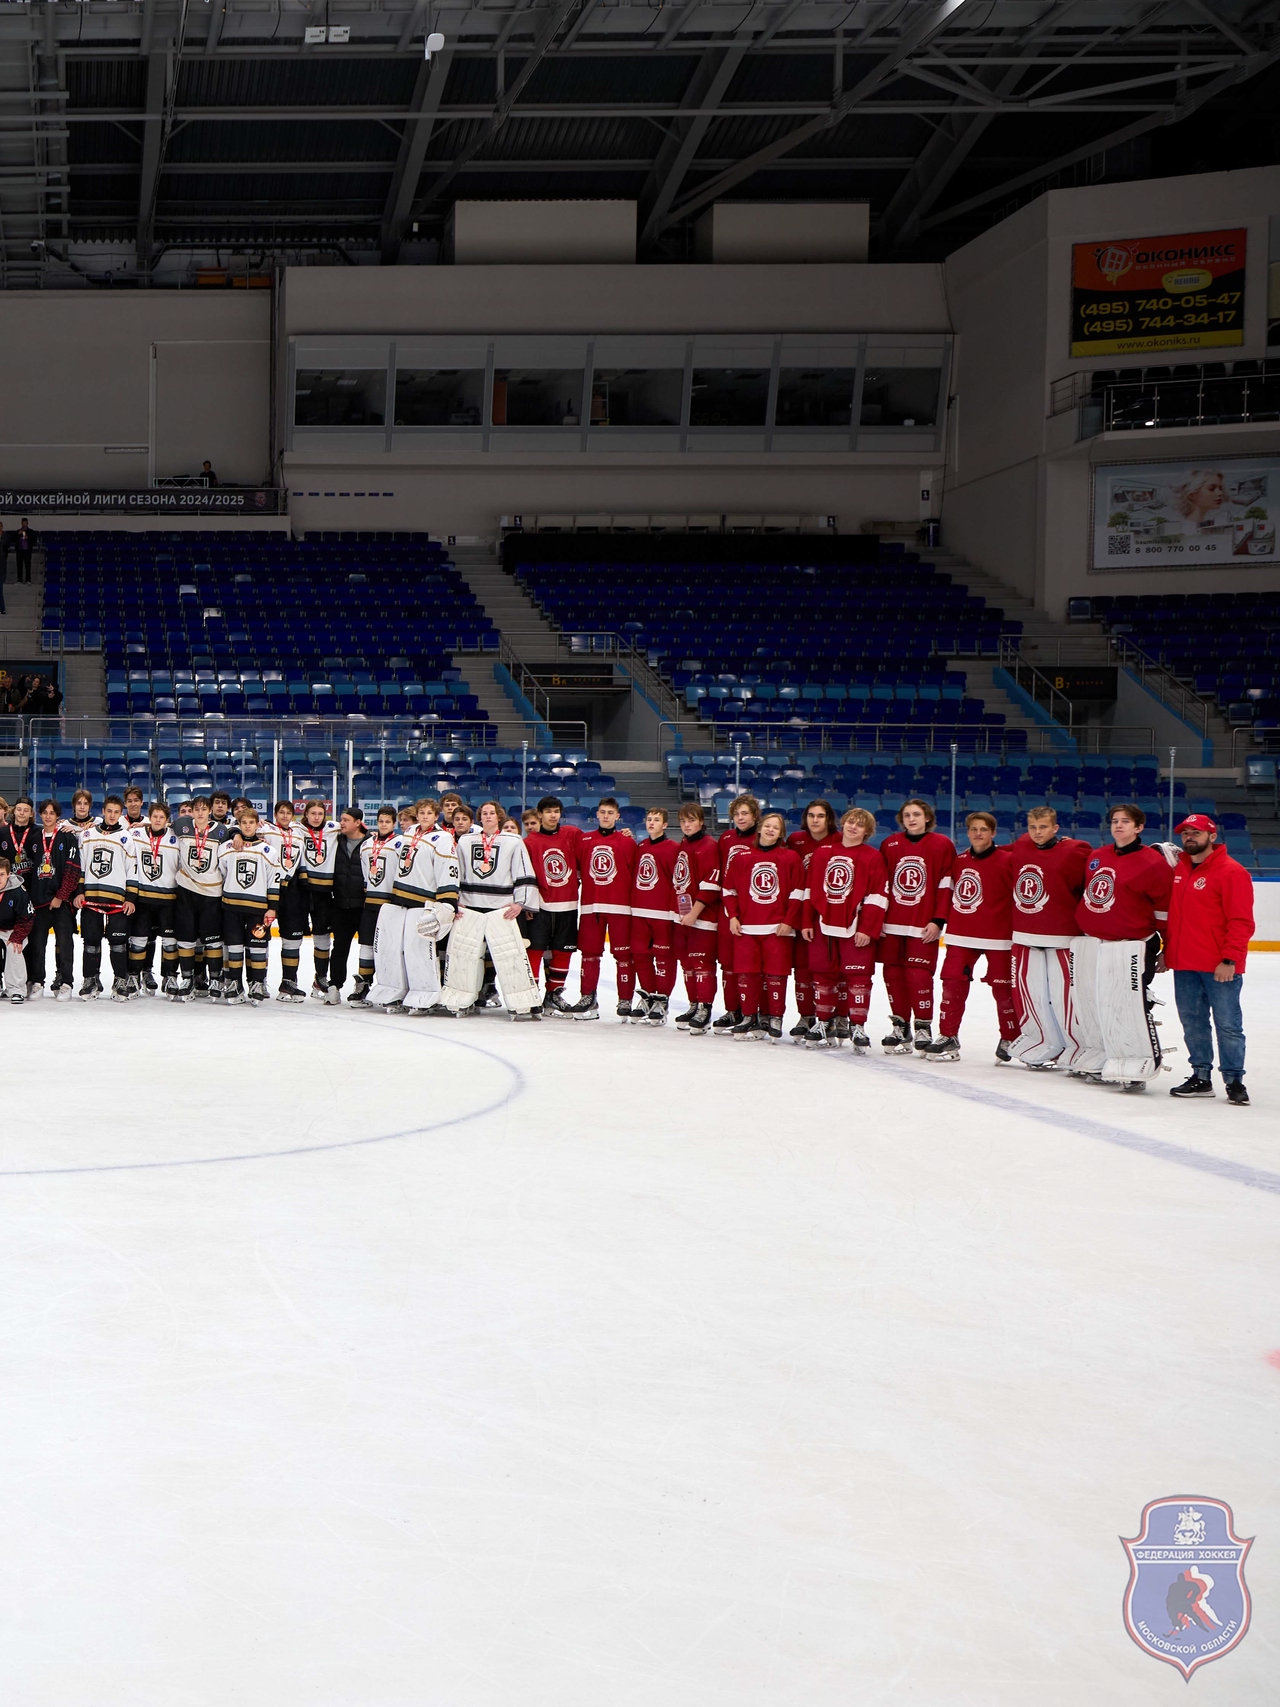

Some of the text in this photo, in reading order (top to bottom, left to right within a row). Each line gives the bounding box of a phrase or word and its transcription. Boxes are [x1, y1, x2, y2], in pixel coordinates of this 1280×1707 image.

[1135, 244, 1236, 264] ОКОНИКС
[1080, 292, 1242, 318] (495) 740-05-47
[1083, 310, 1237, 336] (495) 744-34-17
[1116, 336, 1200, 350] www.okoniks.ru
[16, 492, 91, 505] ХОККЕЙНОЙ
[93, 494, 126, 505] ЛИГИ
[129, 494, 177, 505] СЕЗОНА
[180, 494, 245, 506] 2024/2025
[1146, 546, 1162, 554] 800
[620, 974, 628, 982] 13
[773, 992, 778, 1000] 9
[854, 995, 864, 1003] 81
[918, 1000, 931, 1008] 99
[1146, 1013, 1161, 1058] VAUGHN
